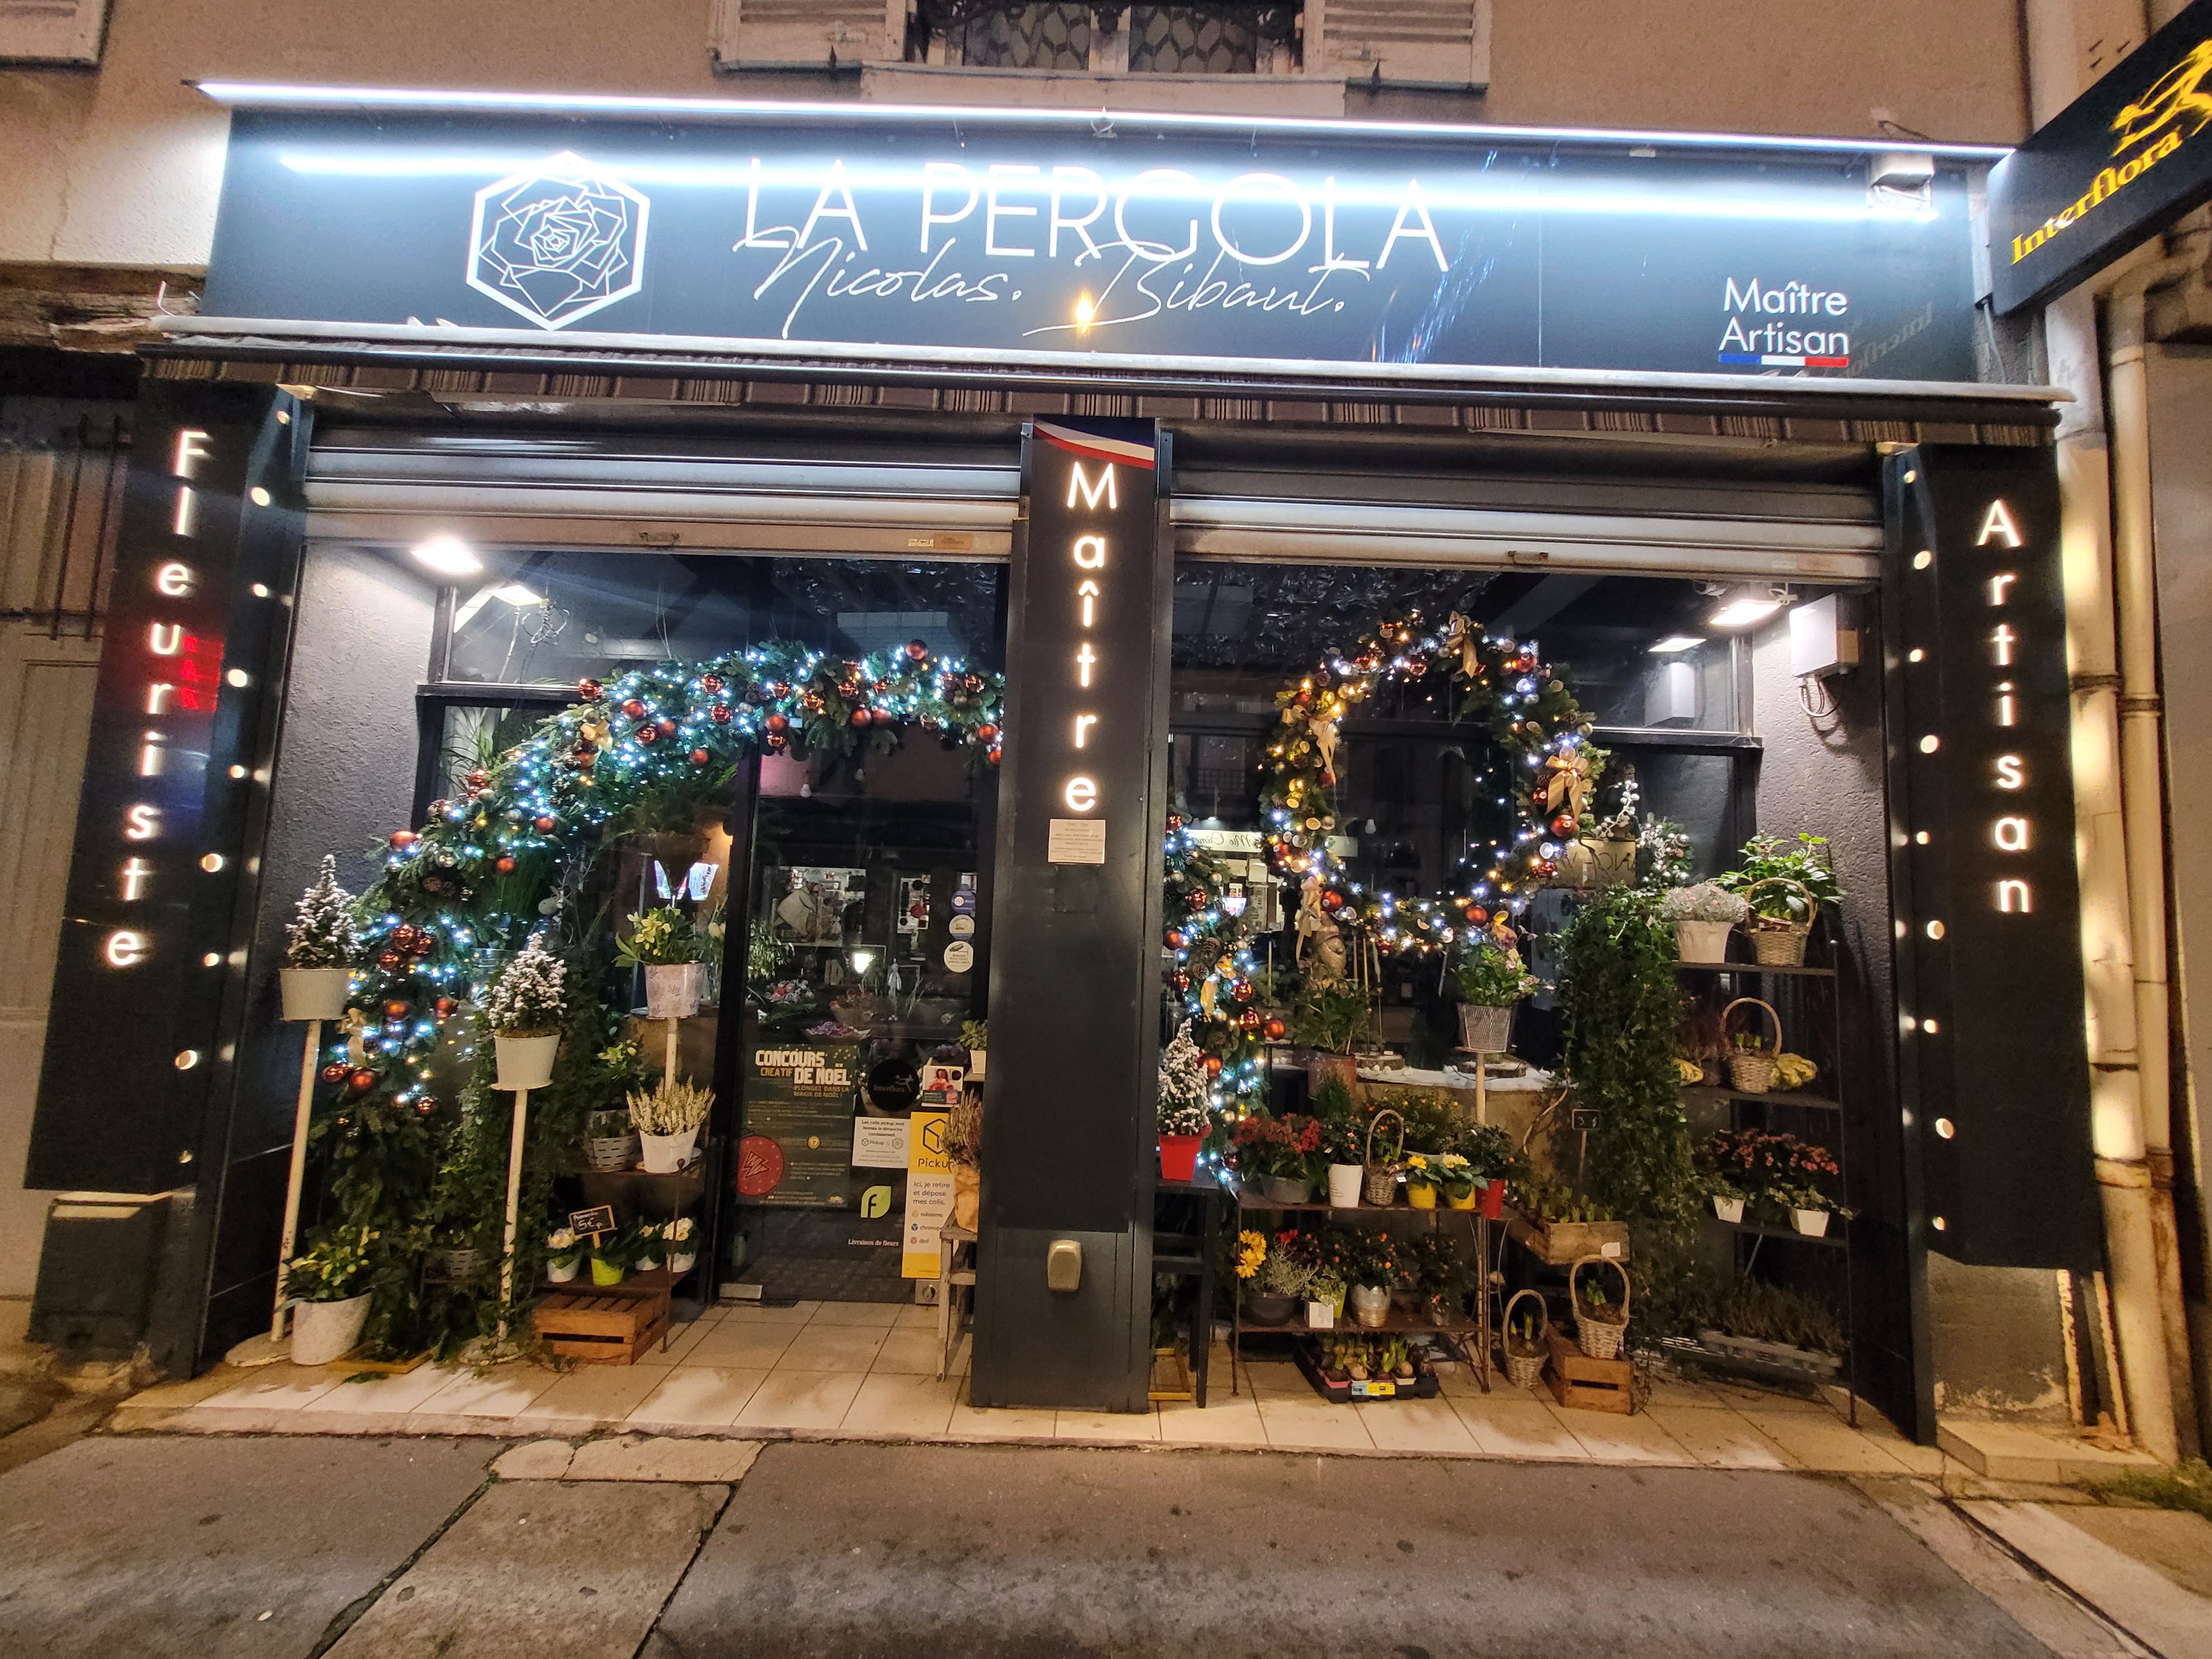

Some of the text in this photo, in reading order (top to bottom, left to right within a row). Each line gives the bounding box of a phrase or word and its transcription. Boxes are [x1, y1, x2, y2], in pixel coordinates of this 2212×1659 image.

[745, 158, 1450, 272] LA PERGOLA
[2011, 125, 2183, 264] Interflora
[1723, 276, 1848, 316] Maître
[1718, 316, 1849, 355] Artisan
[1066, 461, 1118, 812] Maître
[107, 430, 210, 966] Fleuriste
[1976, 498, 2032, 913] Artisan
[755, 1050, 826, 1067] CONCOURS
[794, 1068, 813, 1084] DE
[816, 1063, 851, 1086] NOËL
[918, 1157, 951, 1168] Picku
